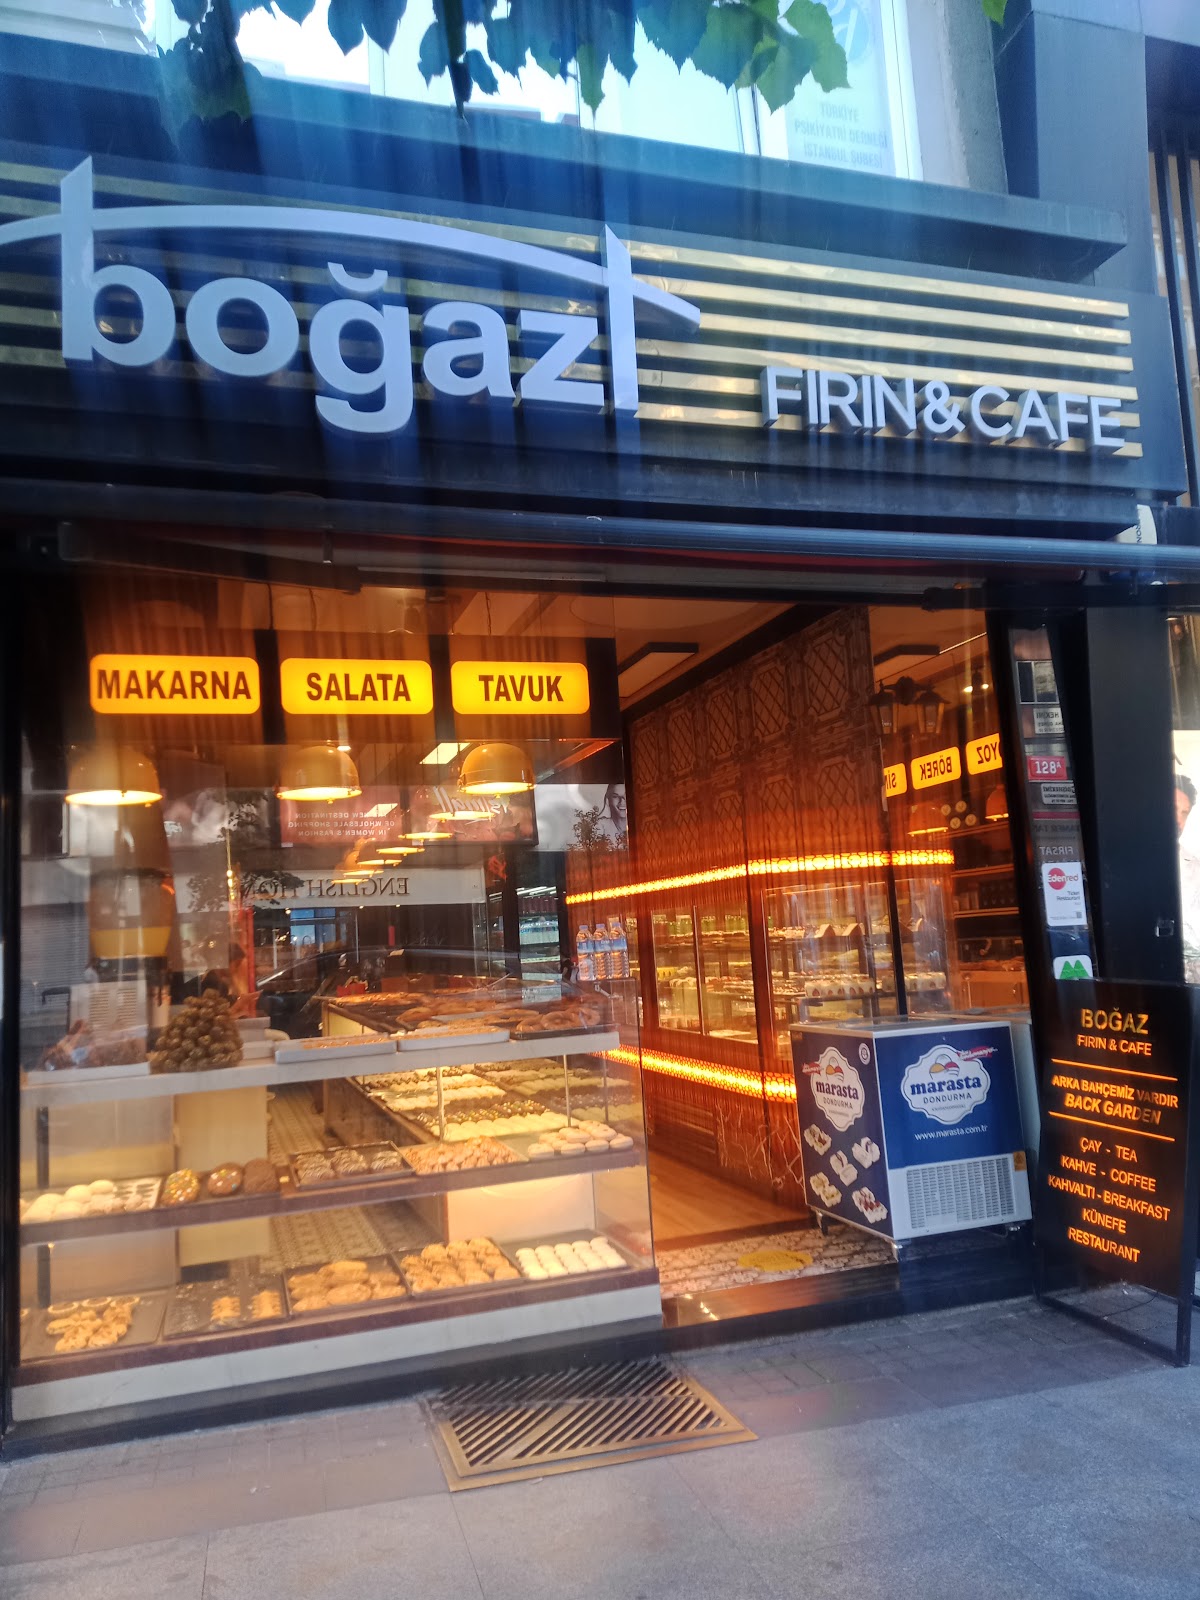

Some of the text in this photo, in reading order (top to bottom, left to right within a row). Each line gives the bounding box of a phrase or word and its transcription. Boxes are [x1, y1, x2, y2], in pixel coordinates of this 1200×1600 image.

[96, 668, 252, 700] MAKARNA
[306, 672, 412, 702] SALATA
[478, 674, 565, 702] TAVUK
[1047, 873, 1079, 883] Edenred
[1081, 1008, 1149, 1034] BOĞAZ
[1077, 1035, 1152, 1055] FIRIN & CAFE
[815, 1081, 859, 1100] marasta
[911, 1076, 982, 1096] marasta
[923, 1092, 972, 1104] DONDURMA
[1052, 1075, 1178, 1108] ARKA BAHÇEMİZ VARDIR
[822, 1097, 853, 1110] DONDURMA
[1065, 1094, 1162, 1125] BACK GARDEN
[914, 1126, 987, 1140] www.marasta.com.tr
[1080, 1137, 1102, 1153] ÇAY
[1116, 1145, 1137, 1162] TEA
[1061, 1155, 1097, 1175] KAHVE
[1110, 1169, 1157, 1192] COFFEE
[1048, 1175, 1095, 1199] KAHVALTI
[1103, 1191, 1171, 1222] BREAKFAST
[1082, 1207, 1127, 1234] KÜNEFE
[1067, 1227, 1141, 1263] RESTAURANT
